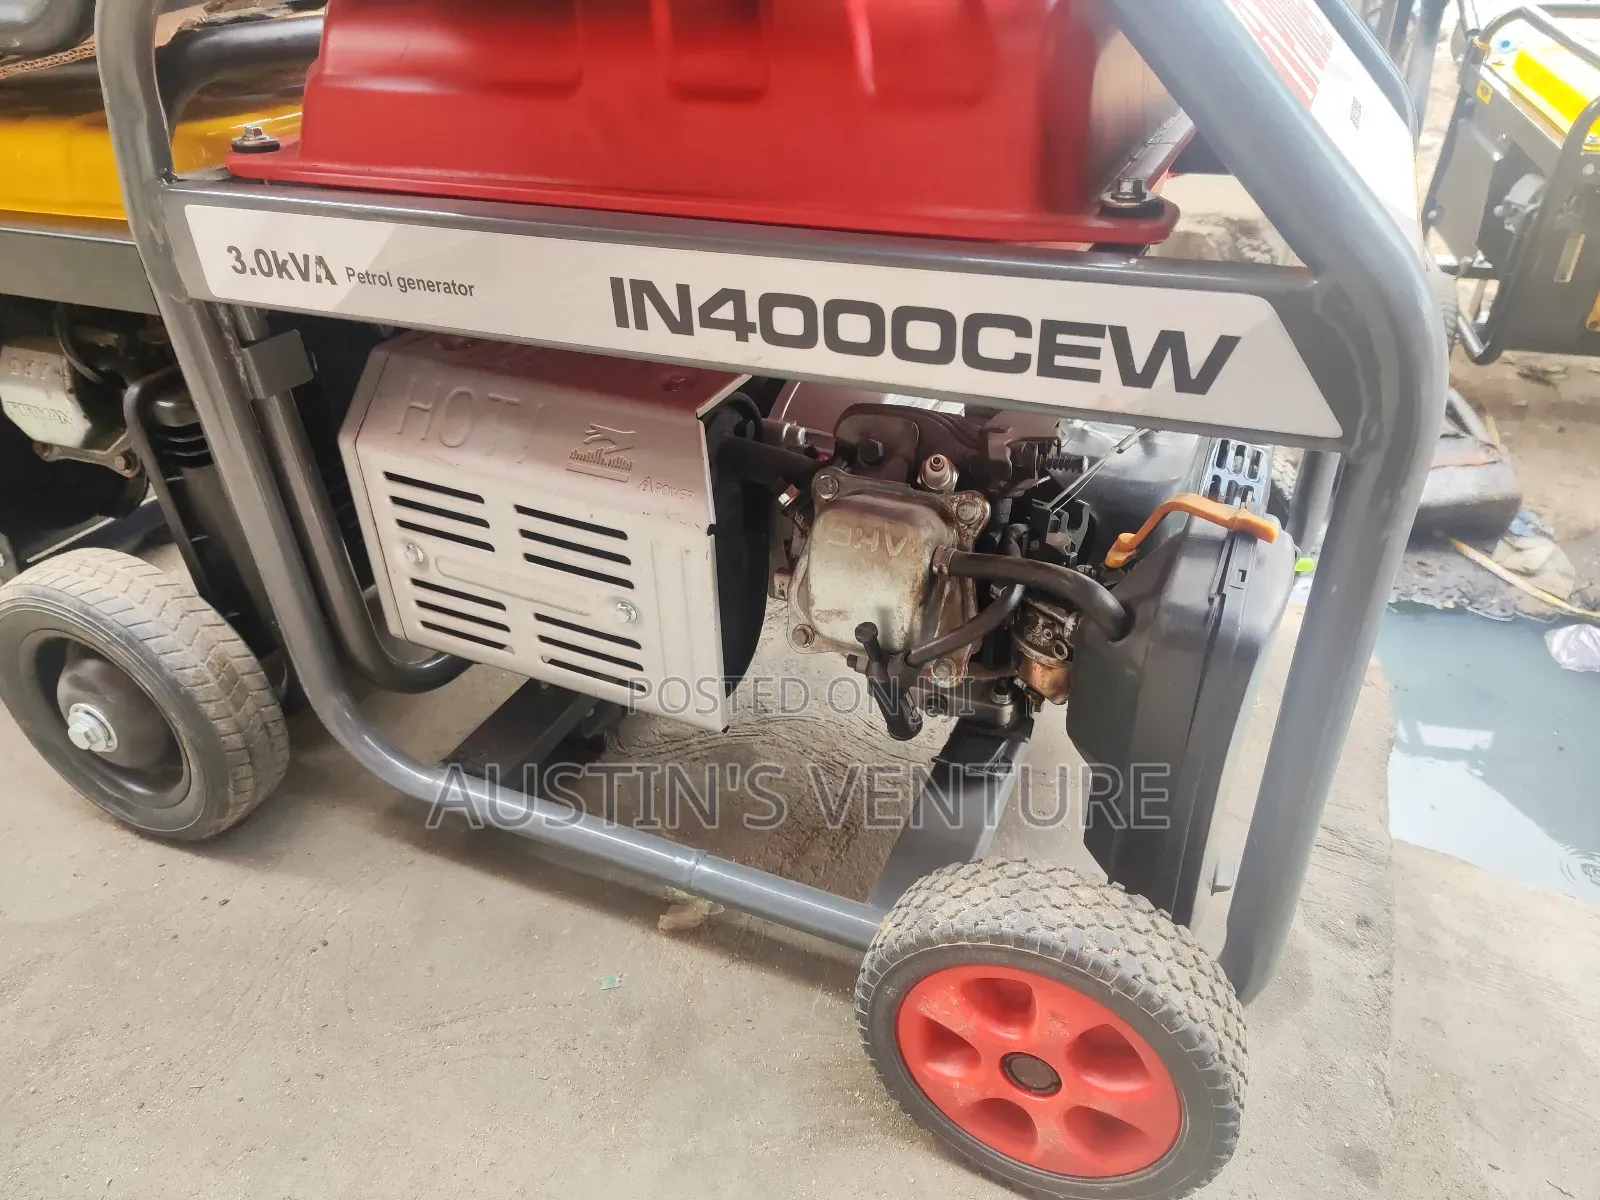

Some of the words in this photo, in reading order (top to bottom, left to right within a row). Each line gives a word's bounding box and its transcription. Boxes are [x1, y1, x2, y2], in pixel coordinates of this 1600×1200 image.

[225, 245, 338, 286] 3.0kVA
[345, 266, 393, 288] Petrol
[396, 274, 475, 298] generator
[609, 276, 1242, 396] IN4000CEW
